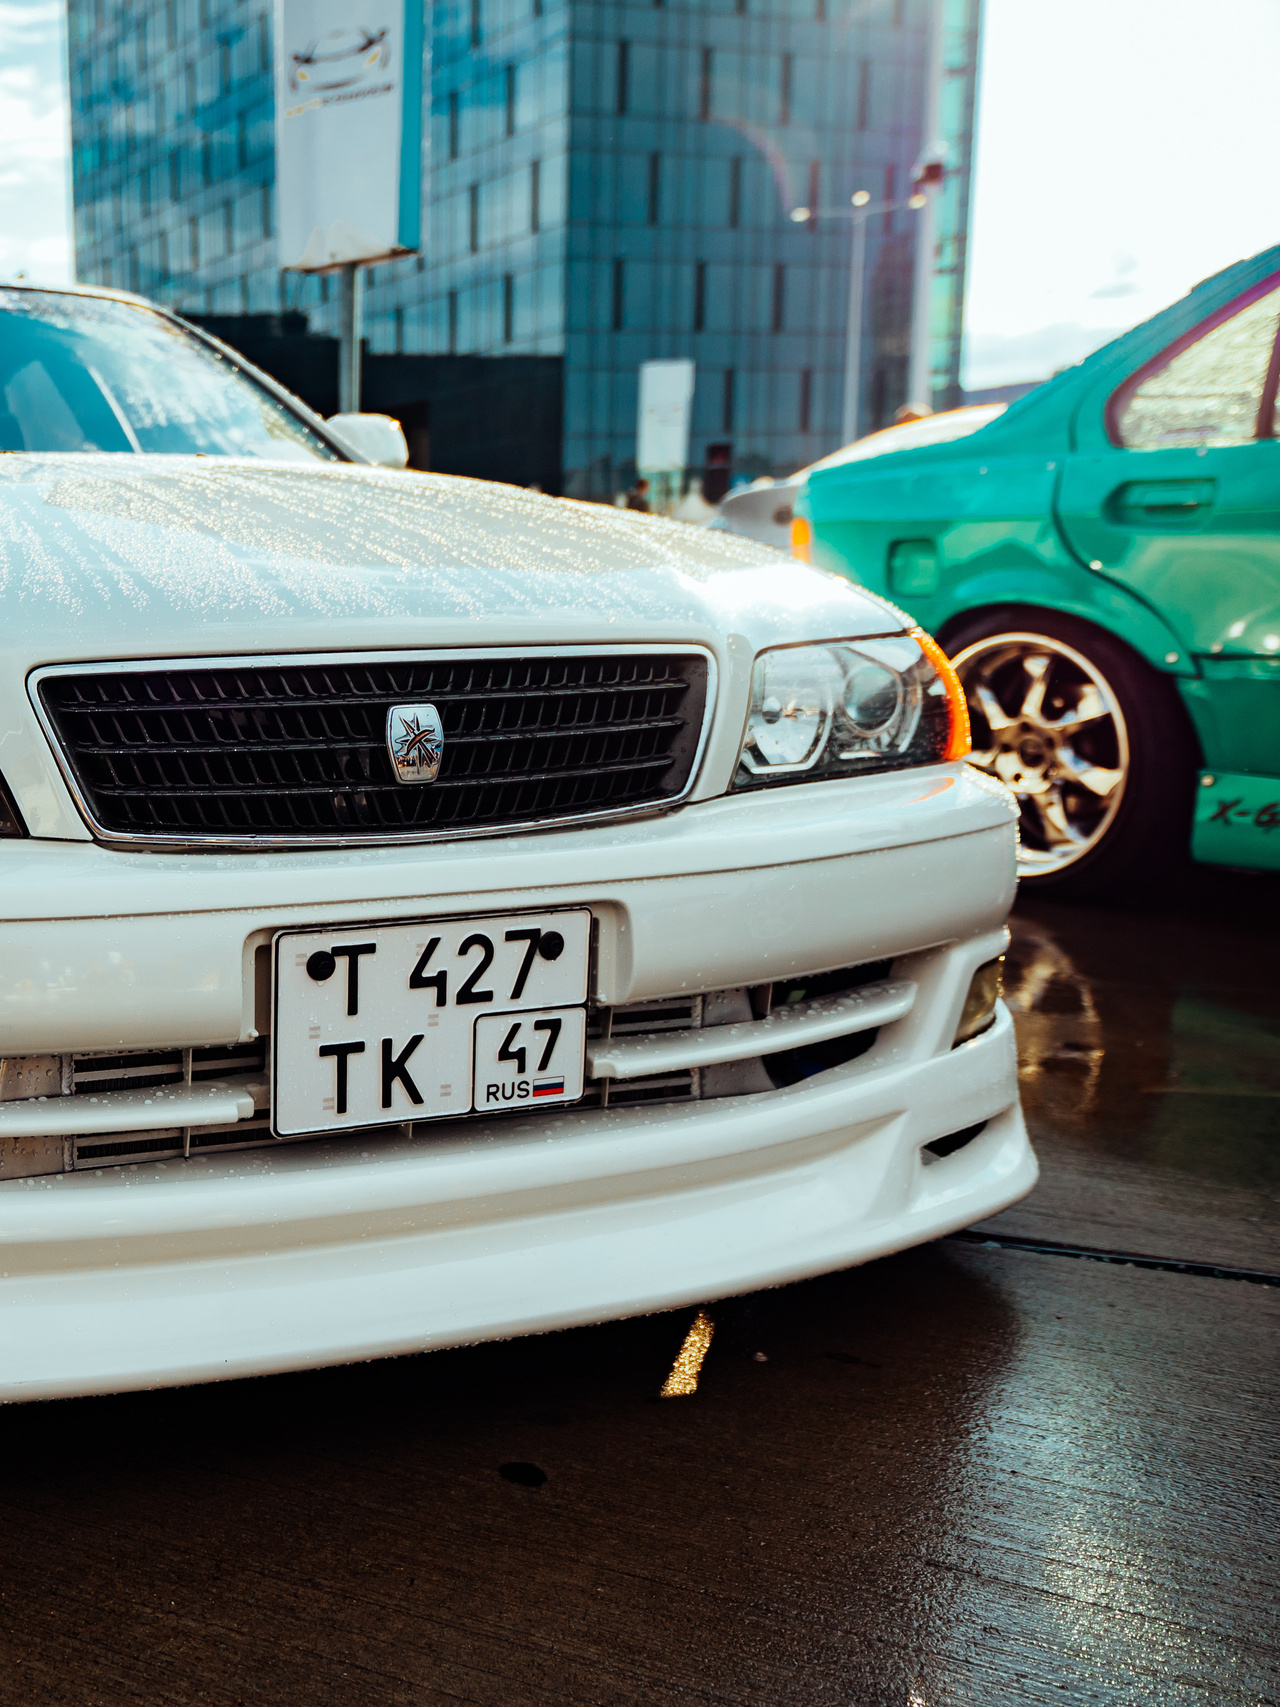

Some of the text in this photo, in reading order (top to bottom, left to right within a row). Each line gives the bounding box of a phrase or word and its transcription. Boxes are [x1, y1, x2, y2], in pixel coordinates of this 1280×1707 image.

[331, 928, 542, 1016] T 427
[319, 1034, 424, 1114] TK
[498, 1018, 562, 1074] 47
[486, 1081, 530, 1103] RUS
